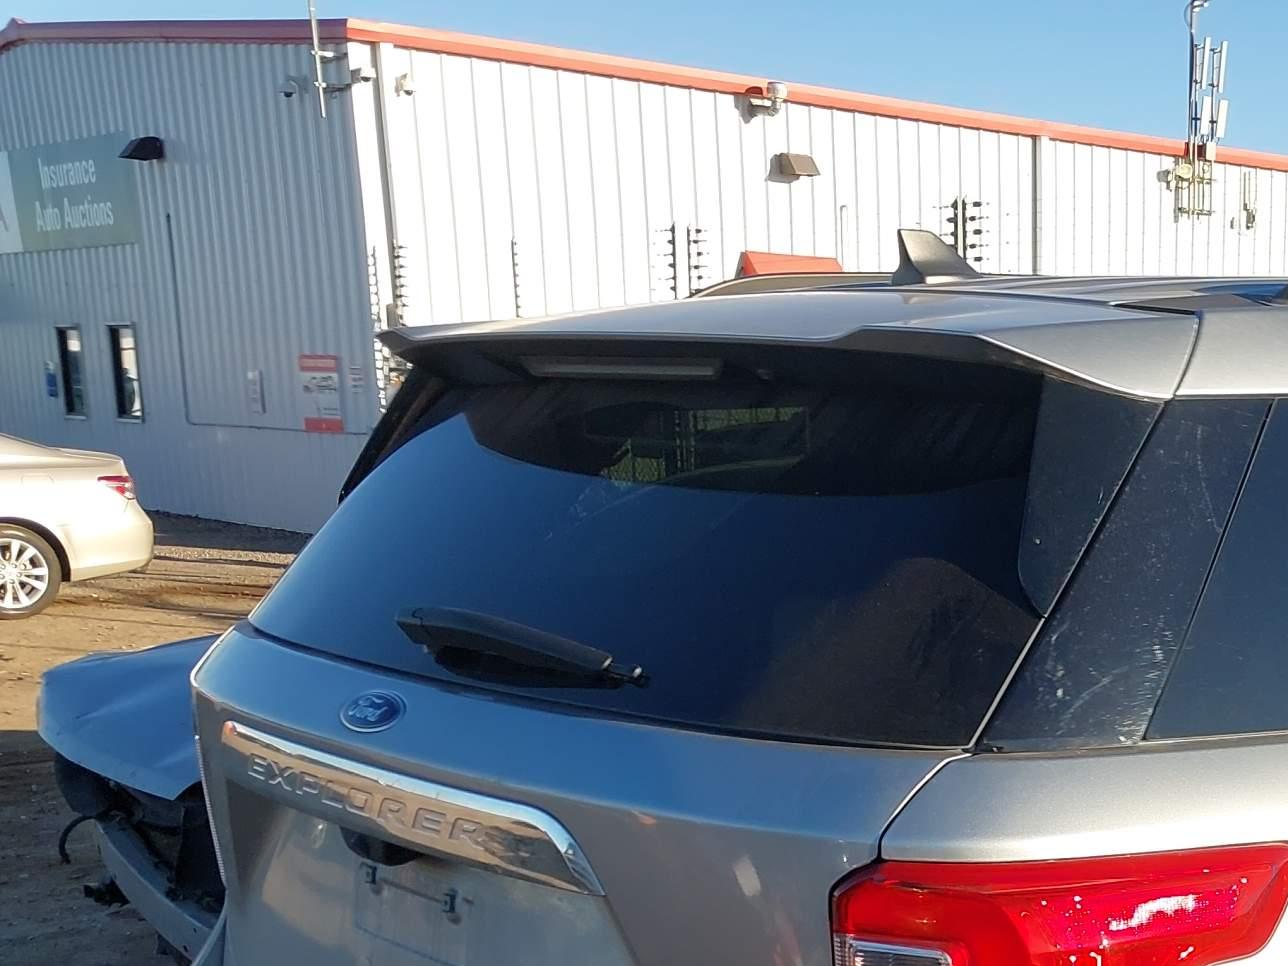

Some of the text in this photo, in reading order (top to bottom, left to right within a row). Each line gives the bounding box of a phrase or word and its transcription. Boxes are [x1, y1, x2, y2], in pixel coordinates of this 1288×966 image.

[38, 158, 97, 190] Insurance
[35, 200, 61, 232] Auto
[63, 195, 114, 229] Auctions
[347, 694, 389, 722] Ford
[247, 752, 488, 843] EXPLORER
